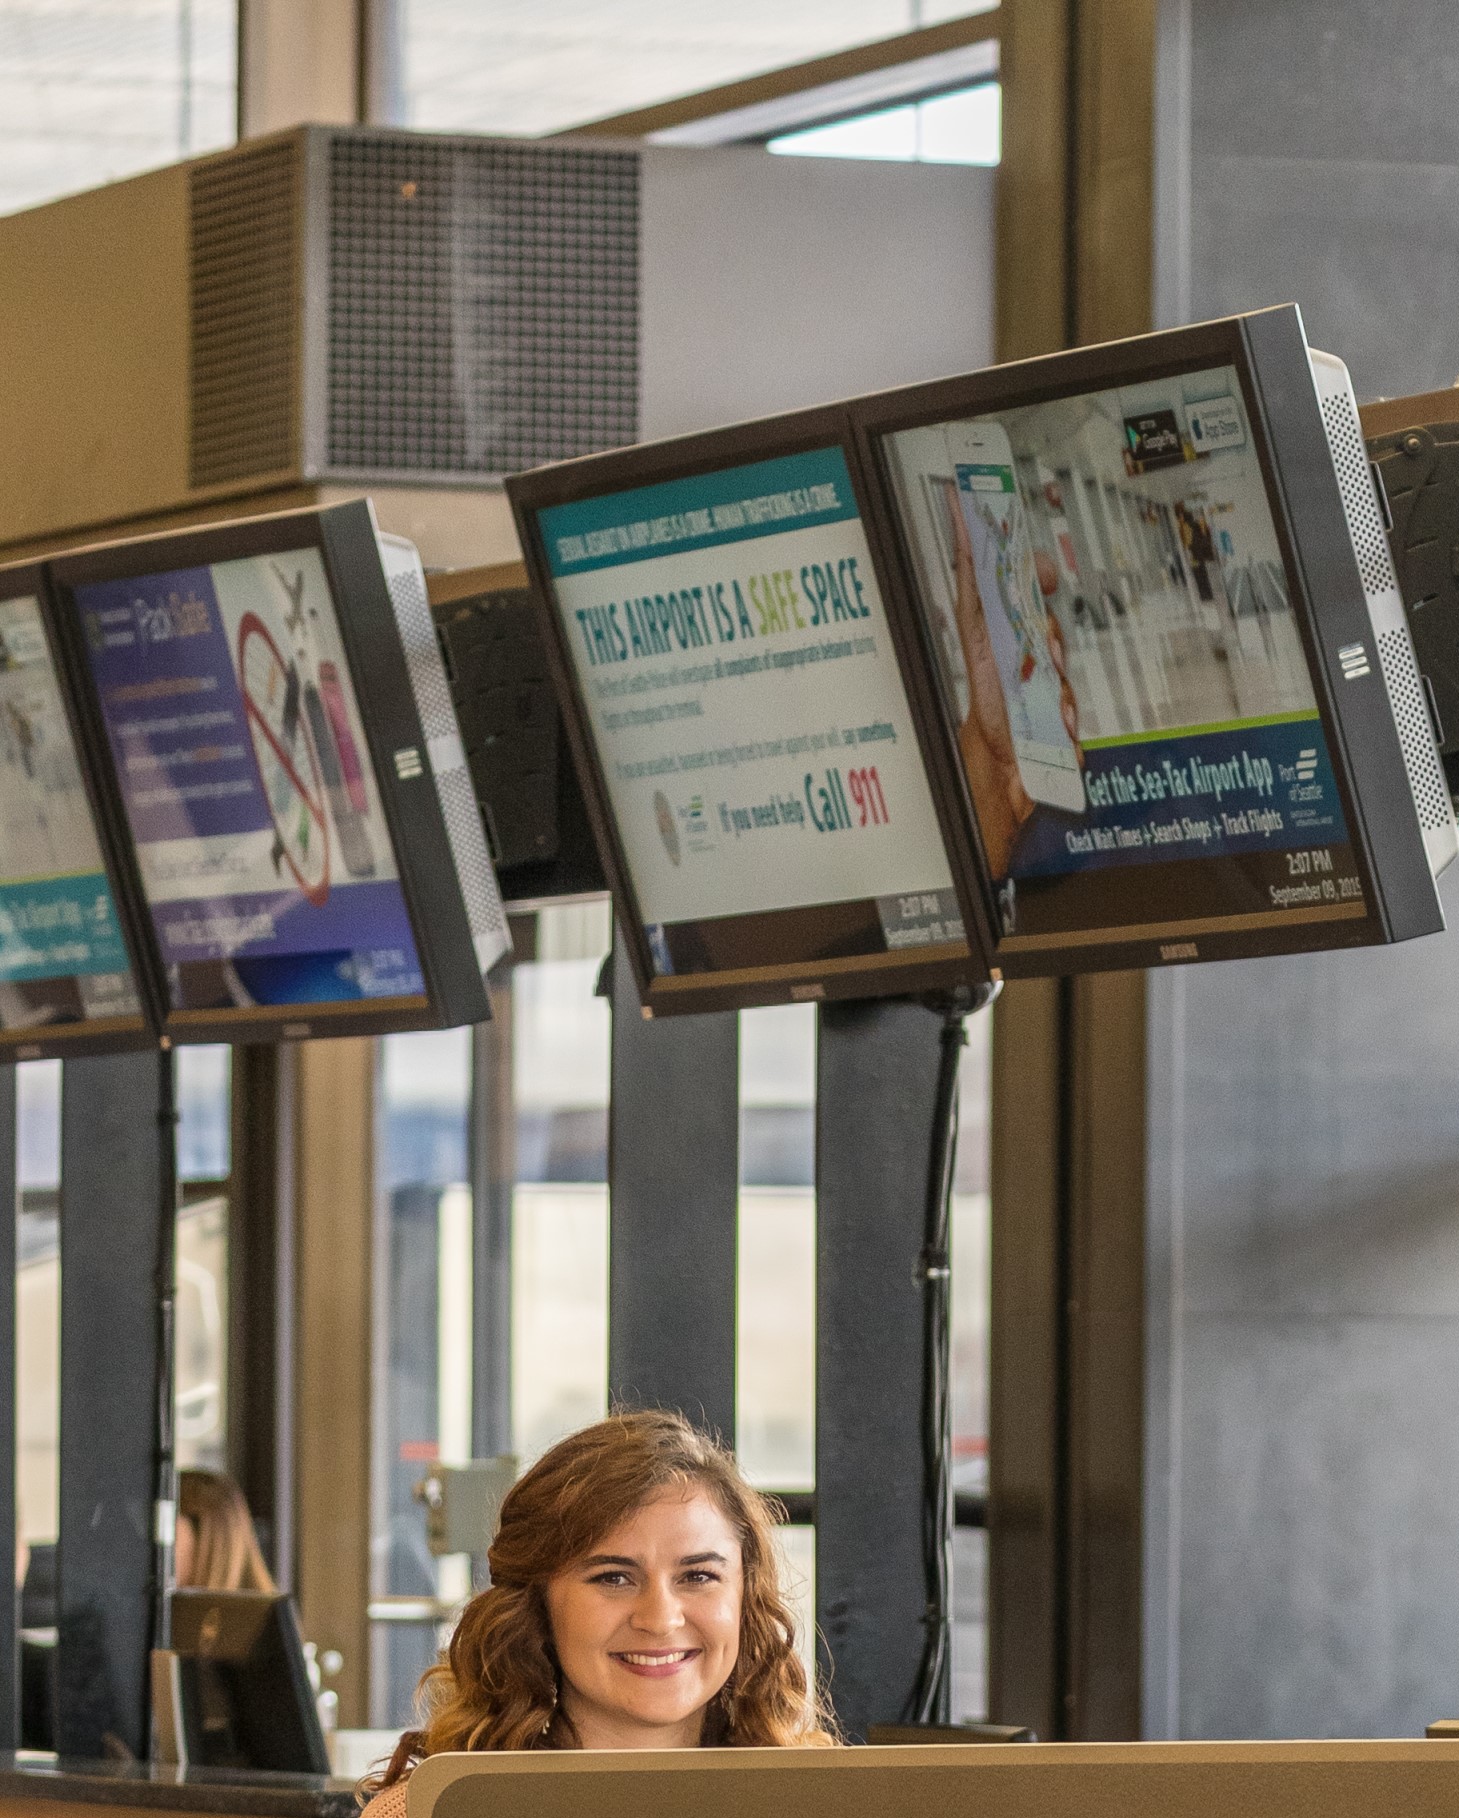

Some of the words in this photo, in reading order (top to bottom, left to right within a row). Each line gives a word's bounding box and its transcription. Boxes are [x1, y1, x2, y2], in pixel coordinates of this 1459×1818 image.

[575, 602, 629, 666] THIS
[620, 586, 715, 658] AIRPORT
[705, 582, 737, 643] IS
[728, 578, 755, 639] A
[745, 569, 807, 636] SAFE
[797, 556, 871, 627] SPACE
[799, 766, 853, 834] Call
[844, 765, 891, 827] 911
[1085, 771, 1111, 806] Get
[1111, 766, 1137, 803] the
[1136, 760, 1191, 800] Sea-Tac
[1190, 755, 1246, 802] Airport
[1243, 750, 1273, 796] App
[1246, 808, 1284, 838] Flights
[1286, 853, 1311, 876] 2:07
[1312, 850, 1333, 872] PM
[1269, 881, 1321, 907] September
